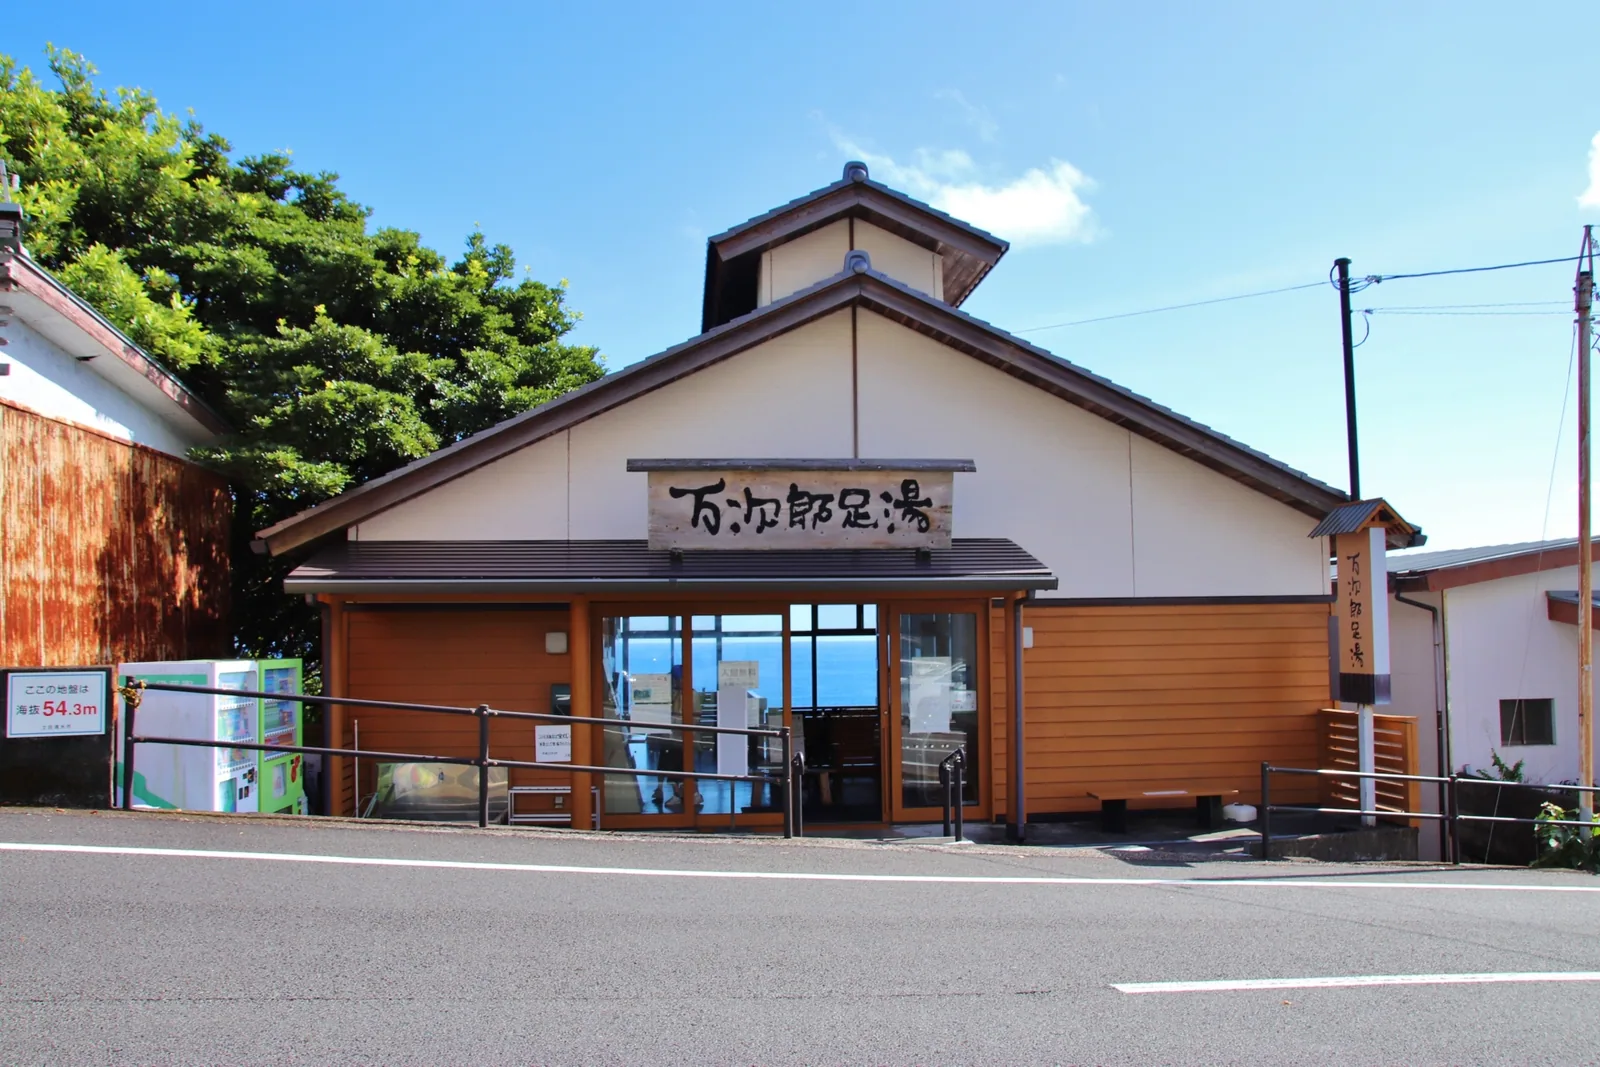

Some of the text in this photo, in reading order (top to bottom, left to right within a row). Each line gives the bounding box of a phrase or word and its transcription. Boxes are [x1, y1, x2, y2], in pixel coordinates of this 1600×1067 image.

[669, 477, 933, 536] 万次郎足湯
[1346, 552, 1364, 668] 万次郎足湯
[25, 684, 89, 695] ここの地盤は
